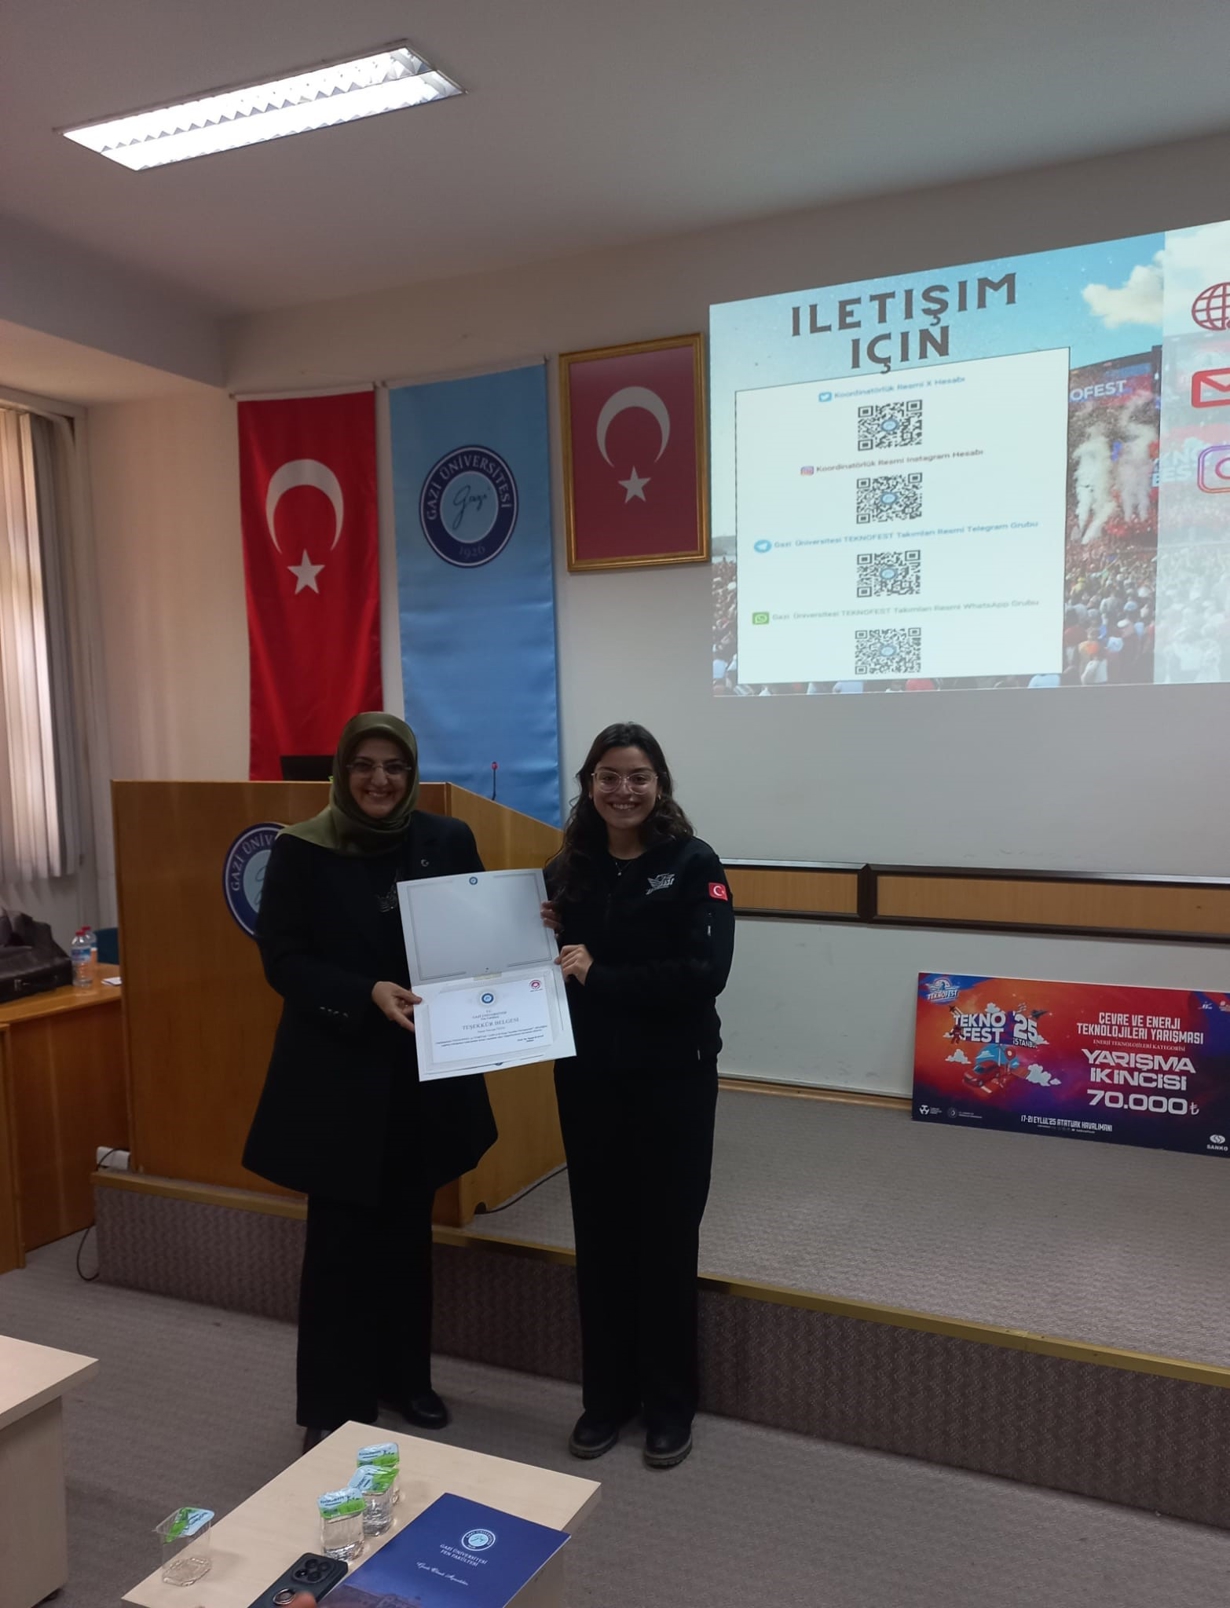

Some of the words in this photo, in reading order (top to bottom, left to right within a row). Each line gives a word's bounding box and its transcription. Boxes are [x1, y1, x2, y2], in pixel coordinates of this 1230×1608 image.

[459, 546, 486, 560] 1926
[954, 1012, 1006, 1028] TEKNO
[1131, 1014, 1145, 1027] VE
[962, 1028, 1005, 1043] FEST
[1150, 1029, 1204, 1045] YARIŞMASI
[1081, 1048, 1197, 1074] YARIŞMA
[1206, 1144, 1229, 1152] SANKO
